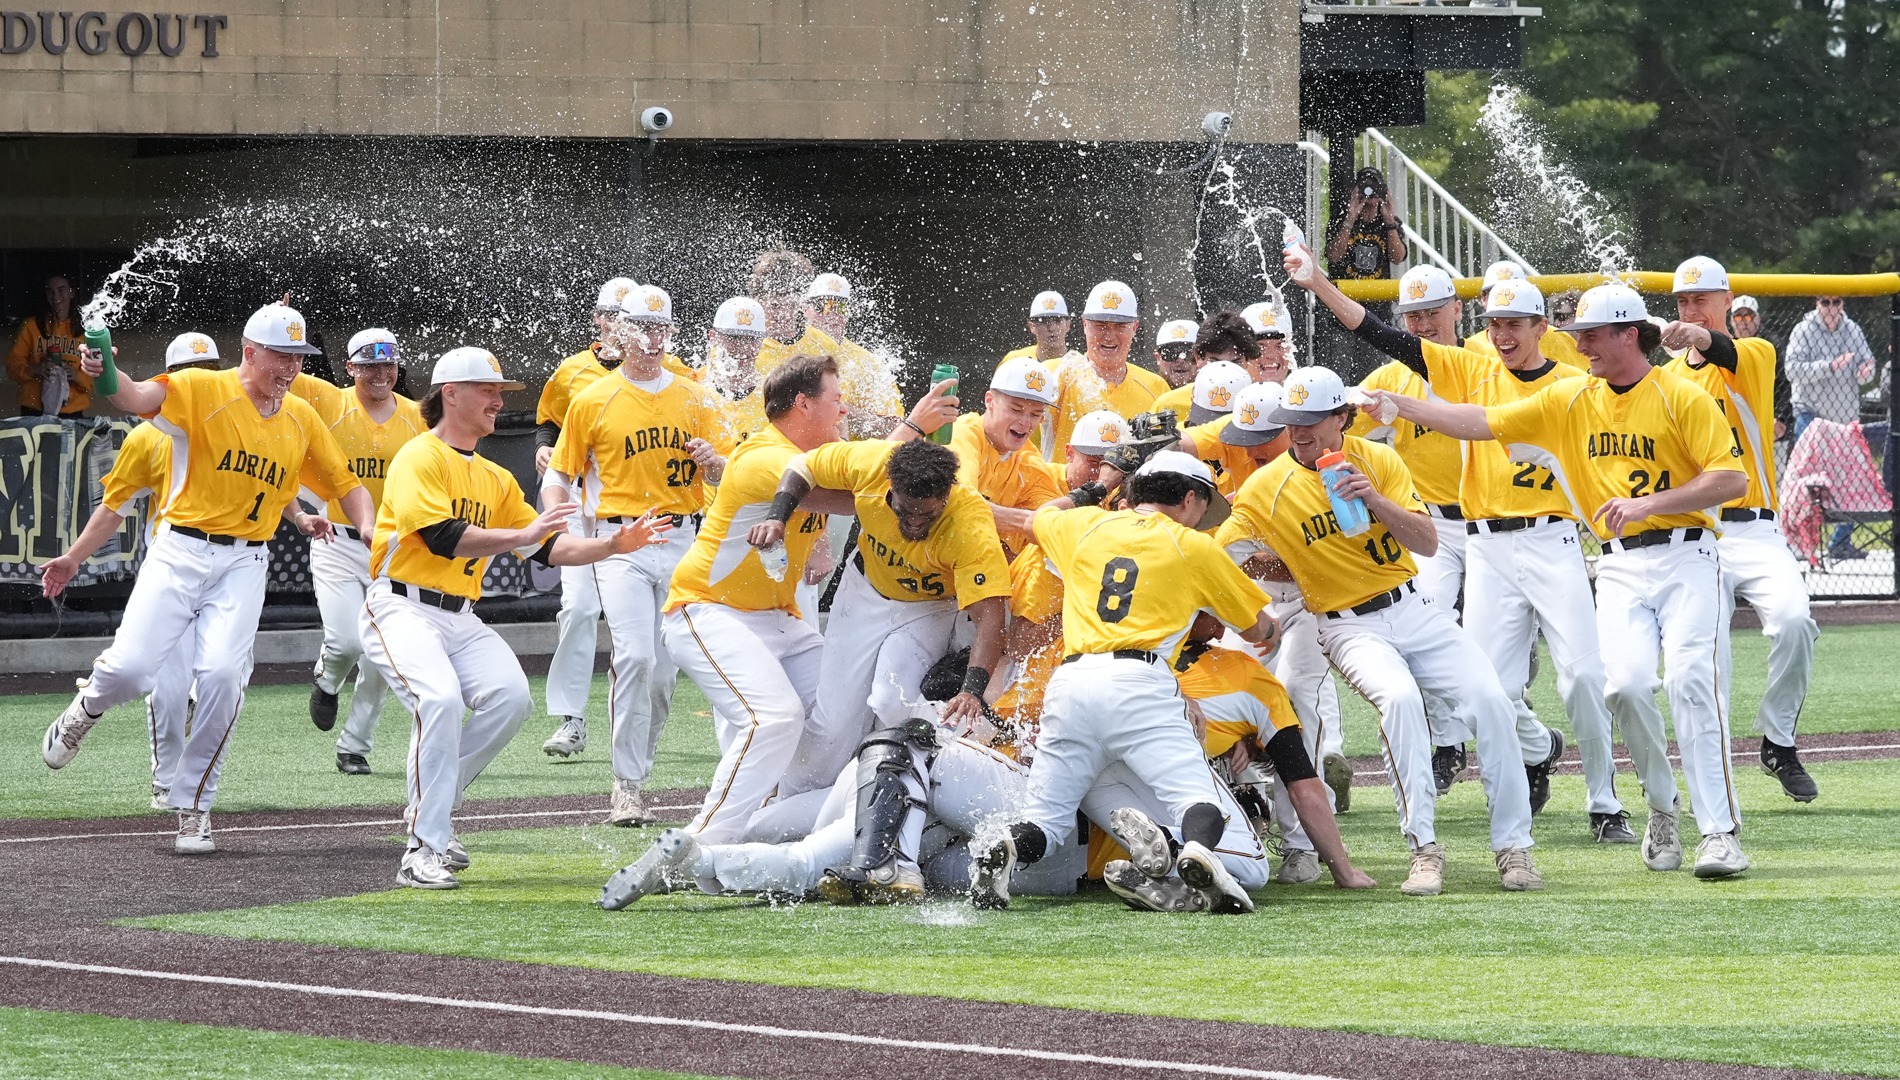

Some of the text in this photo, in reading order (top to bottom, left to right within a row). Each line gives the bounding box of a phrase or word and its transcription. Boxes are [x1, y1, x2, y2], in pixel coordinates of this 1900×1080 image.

[0, 11, 228, 57] DUGOUT
[625, 427, 692, 460] ADRIAN
[1589, 432, 1656, 461] ADRIAN
[216, 449, 286, 491] ADRIAN
[666, 458, 698, 487] 20
[1628, 470, 1672, 498] 24
[246, 491, 266, 522] 1
[1364, 530, 1402, 566] 10
[1096, 556, 1140, 624] 8
